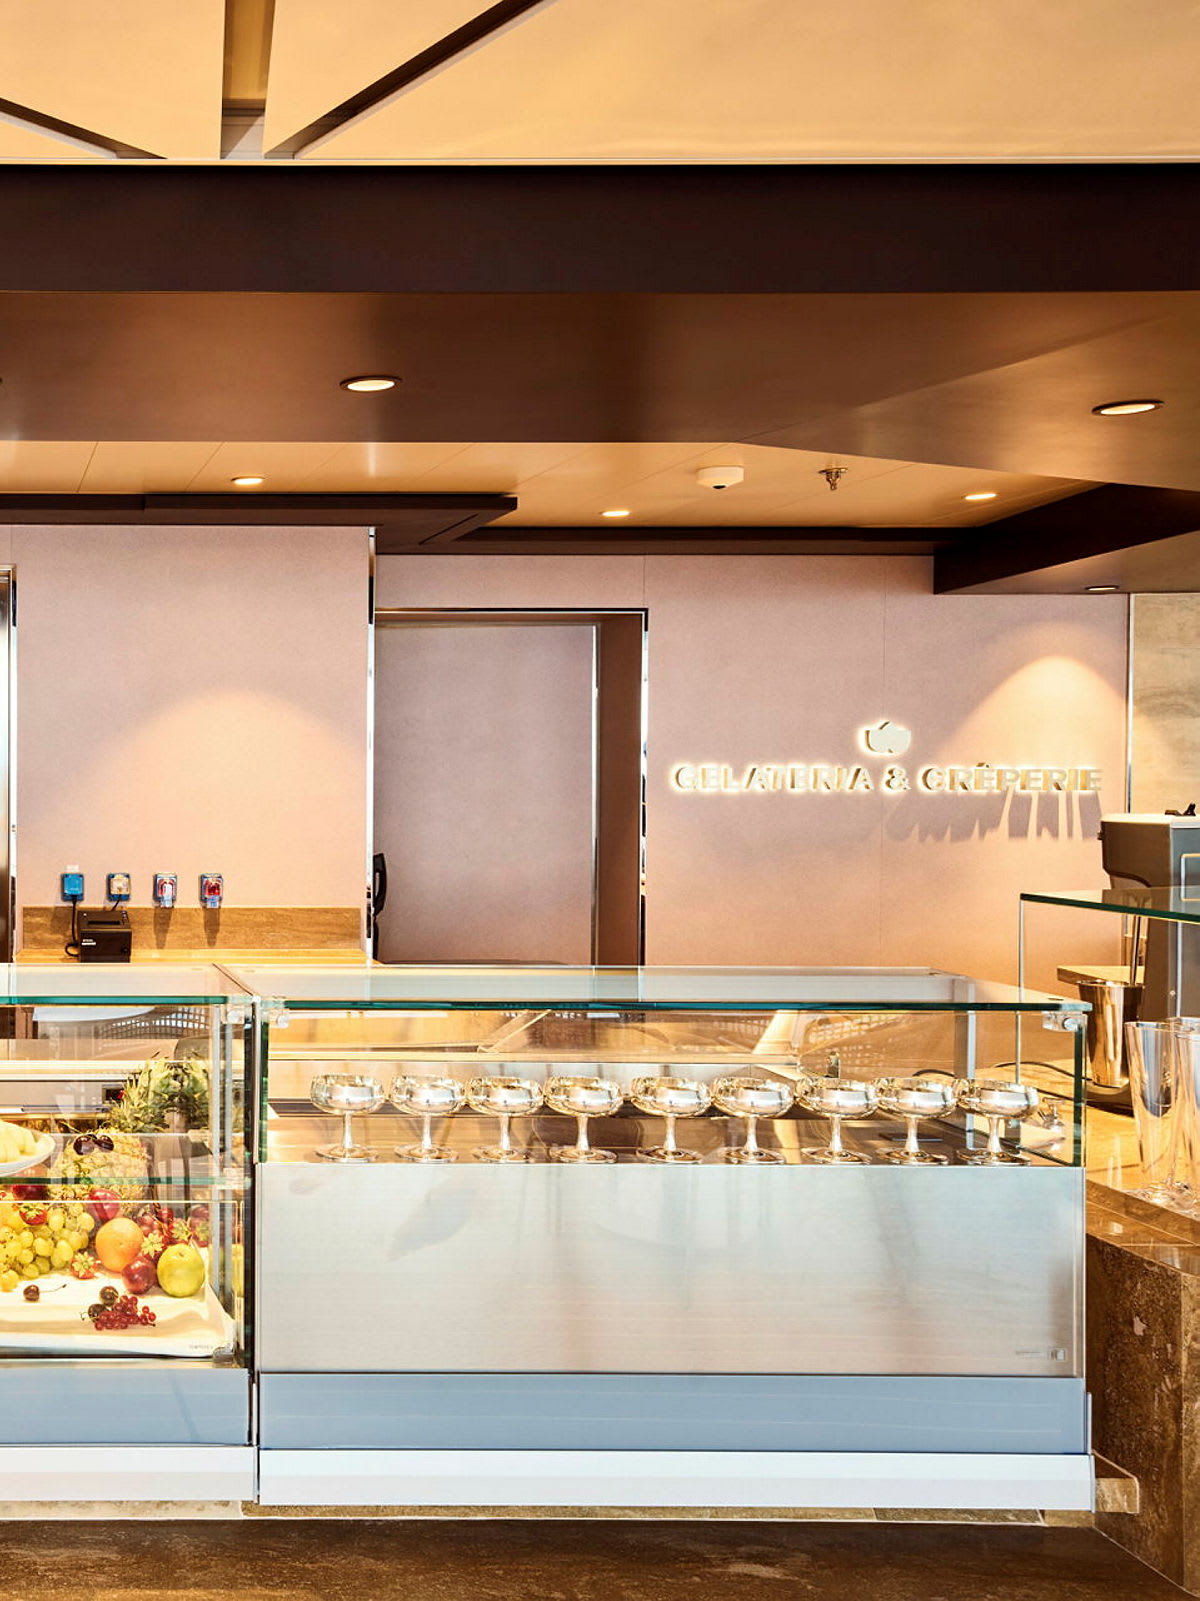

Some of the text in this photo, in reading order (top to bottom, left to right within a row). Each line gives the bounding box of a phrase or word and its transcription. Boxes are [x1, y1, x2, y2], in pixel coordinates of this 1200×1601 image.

[674, 762, 1102, 791] GELATERIA & CRÊPERIE
